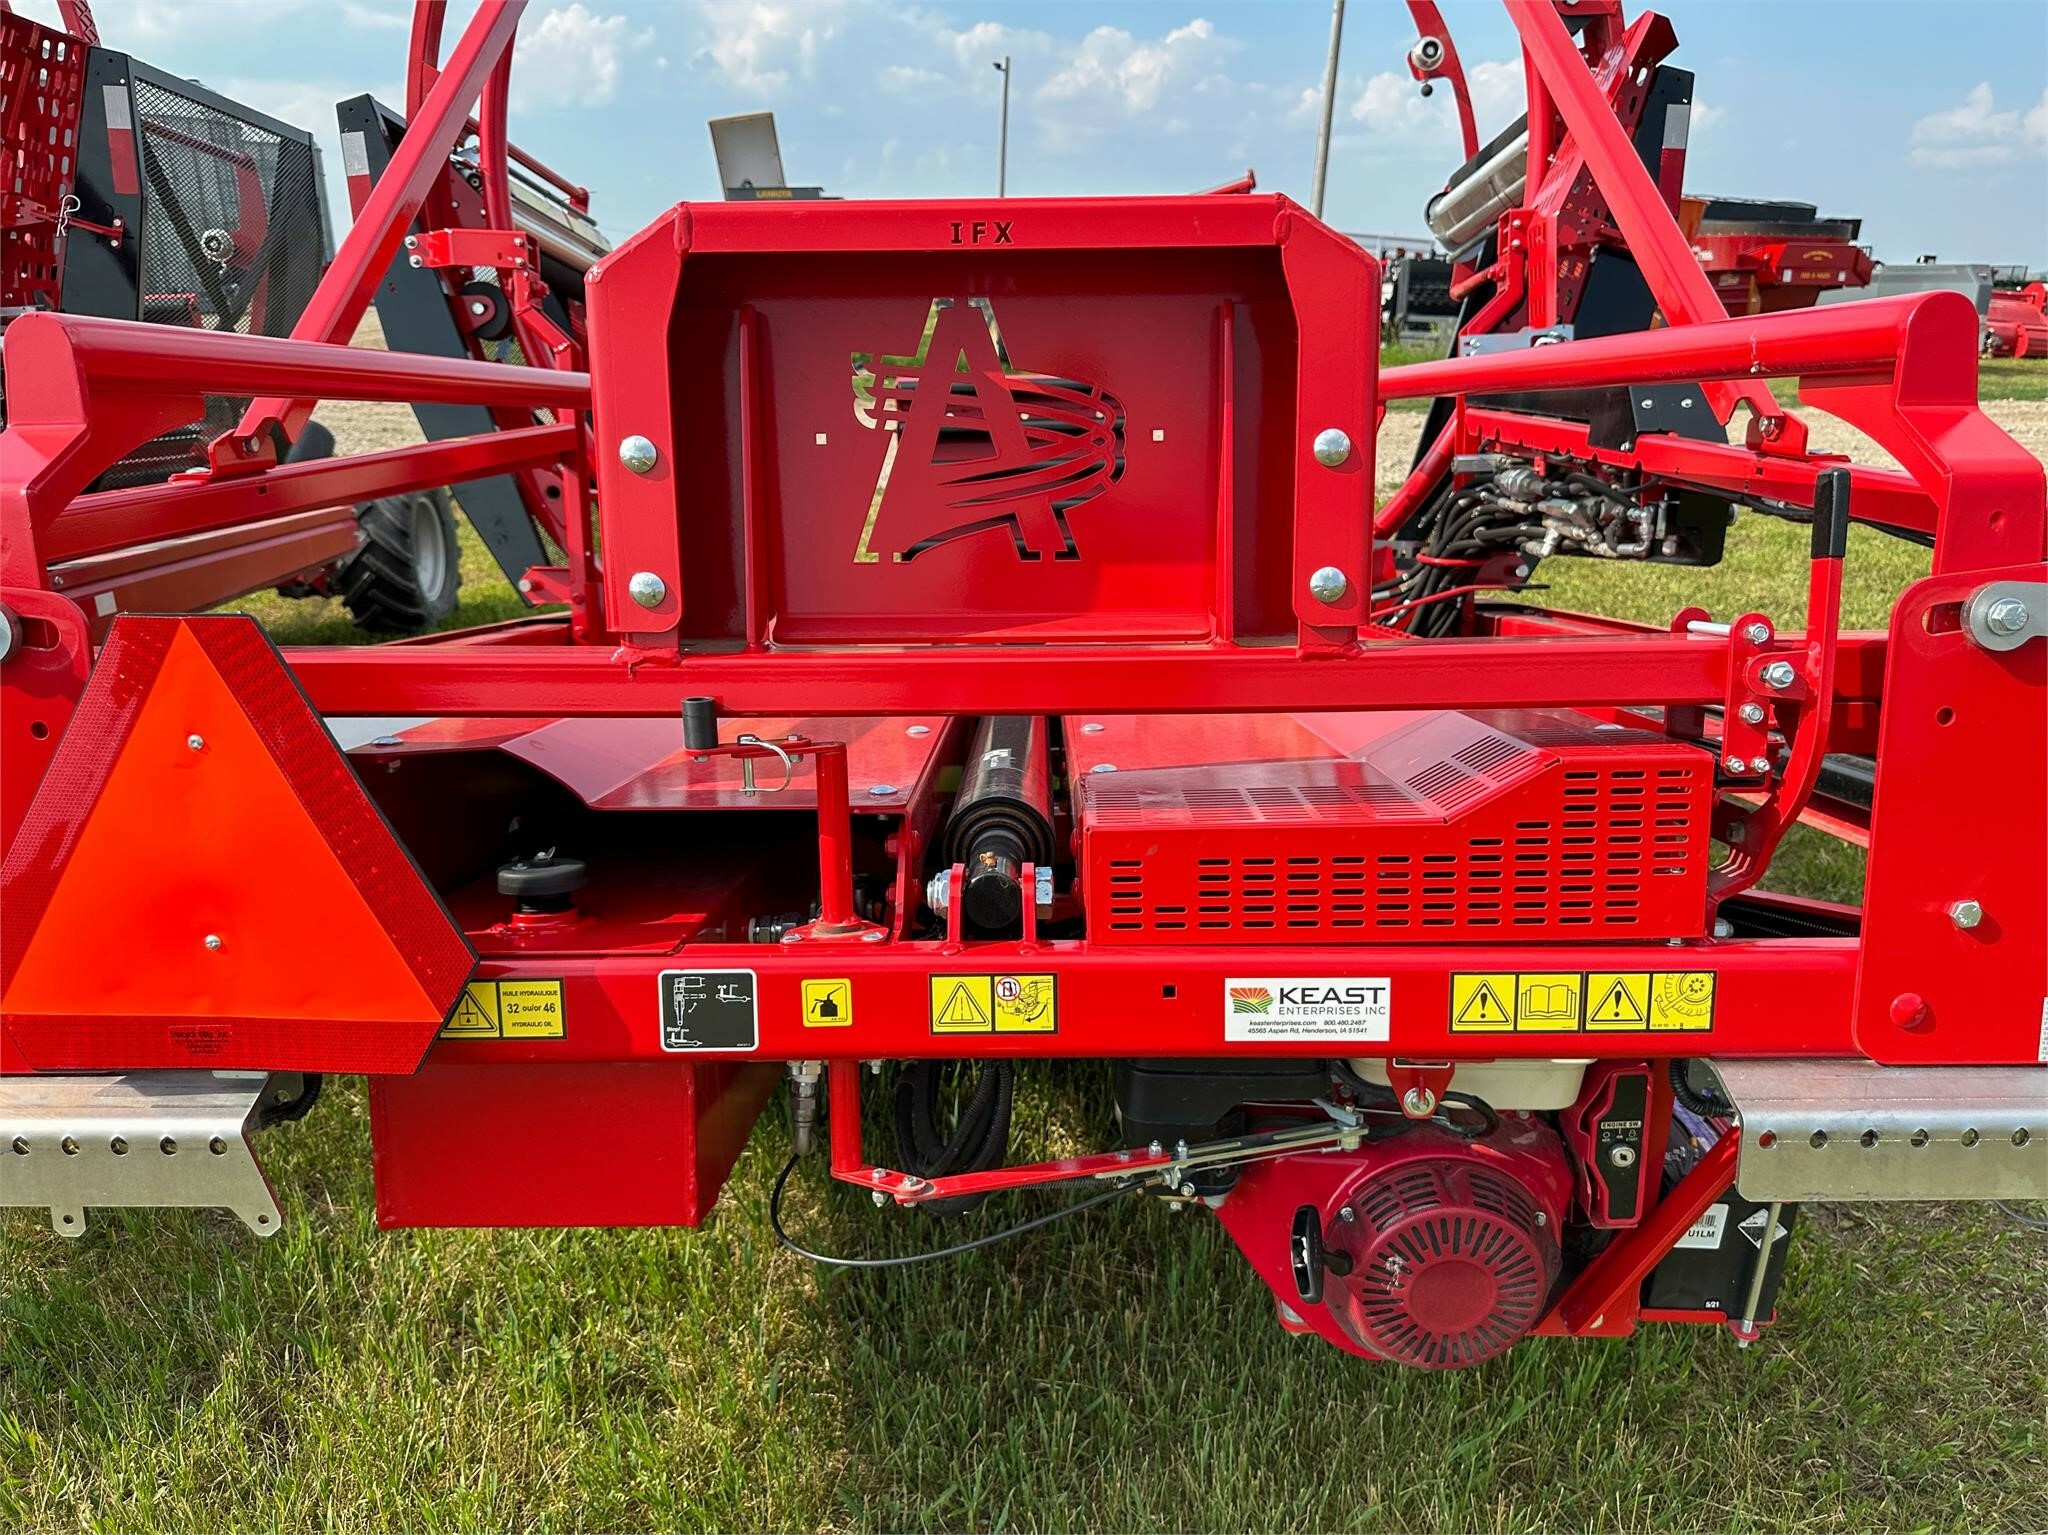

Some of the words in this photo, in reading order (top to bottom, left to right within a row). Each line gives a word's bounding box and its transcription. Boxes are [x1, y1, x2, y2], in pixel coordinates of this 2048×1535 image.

[950, 221, 1014, 245] IFX
[1279, 987, 1386, 1005] KEAST
[507, 1003, 520, 1014] 32
[543, 1002, 556, 1013] 46
[1278, 1006, 1361, 1015] ENTERPRISES
[1365, 1006, 1386, 1015] INC
[1268, 1027, 1288, 1035] Aspen
[1687, 1230, 1716, 1238] U1LM
